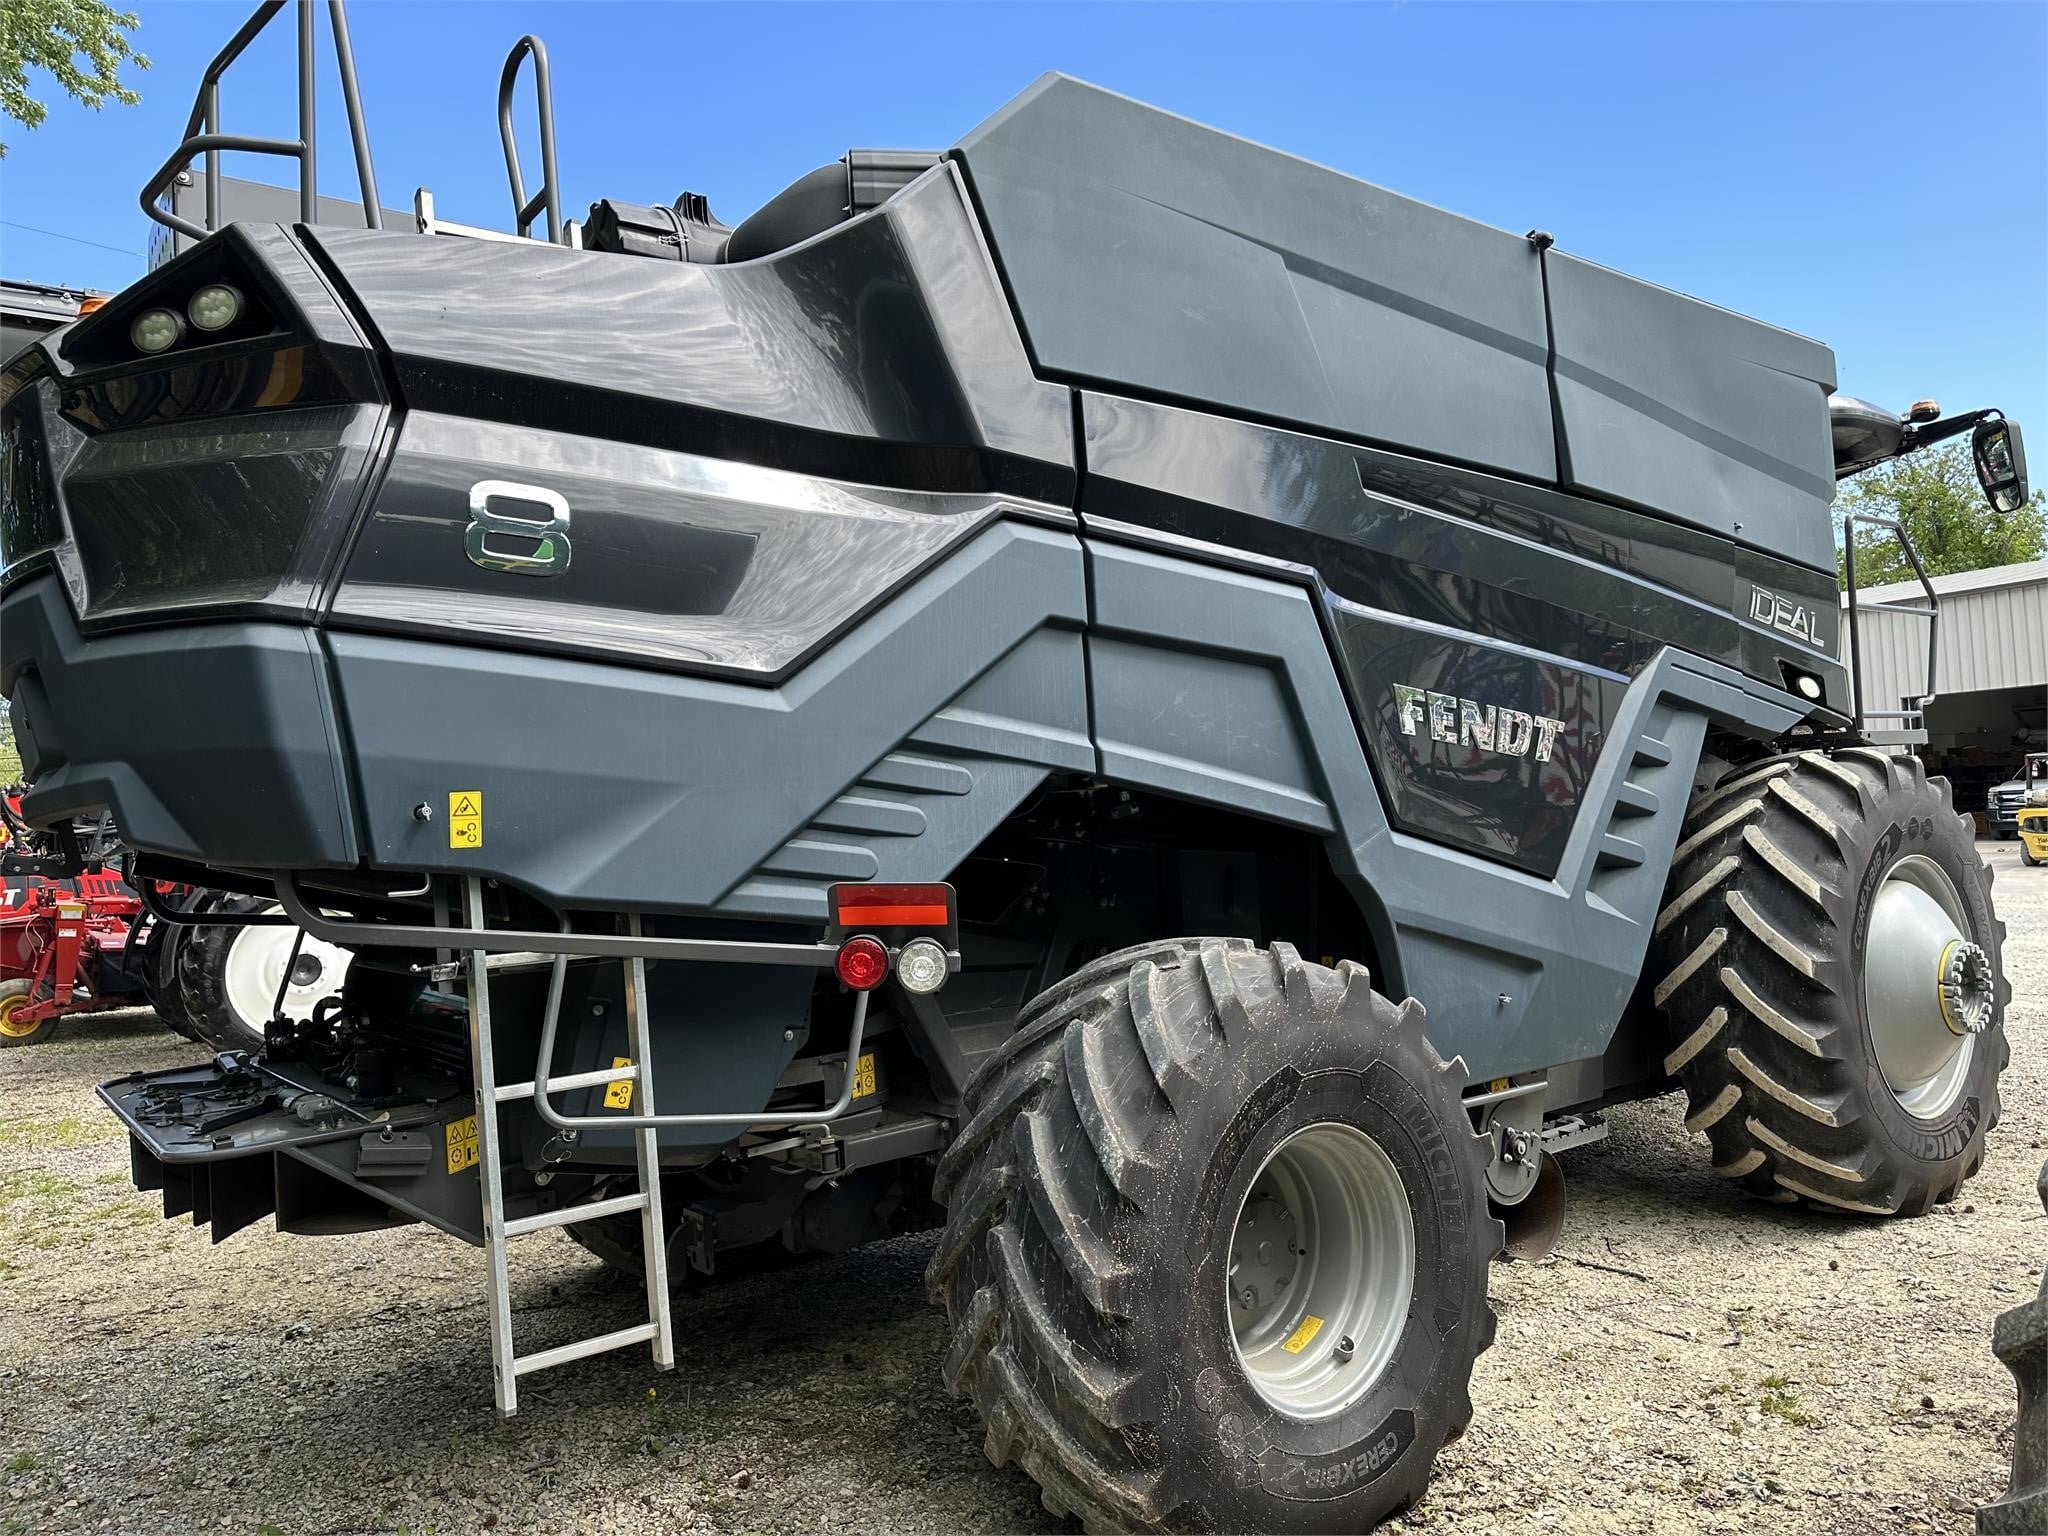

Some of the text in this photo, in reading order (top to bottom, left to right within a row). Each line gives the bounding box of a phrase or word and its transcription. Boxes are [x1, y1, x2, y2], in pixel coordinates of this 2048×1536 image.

[464, 479, 571, 577] 8
[1749, 585, 1824, 647] IDEAL
[1393, 683, 1565, 762] FENDT
[1855, 851, 1883, 950] CEREXBIB
[1305, 1431, 1399, 1489] CEREXBIB
